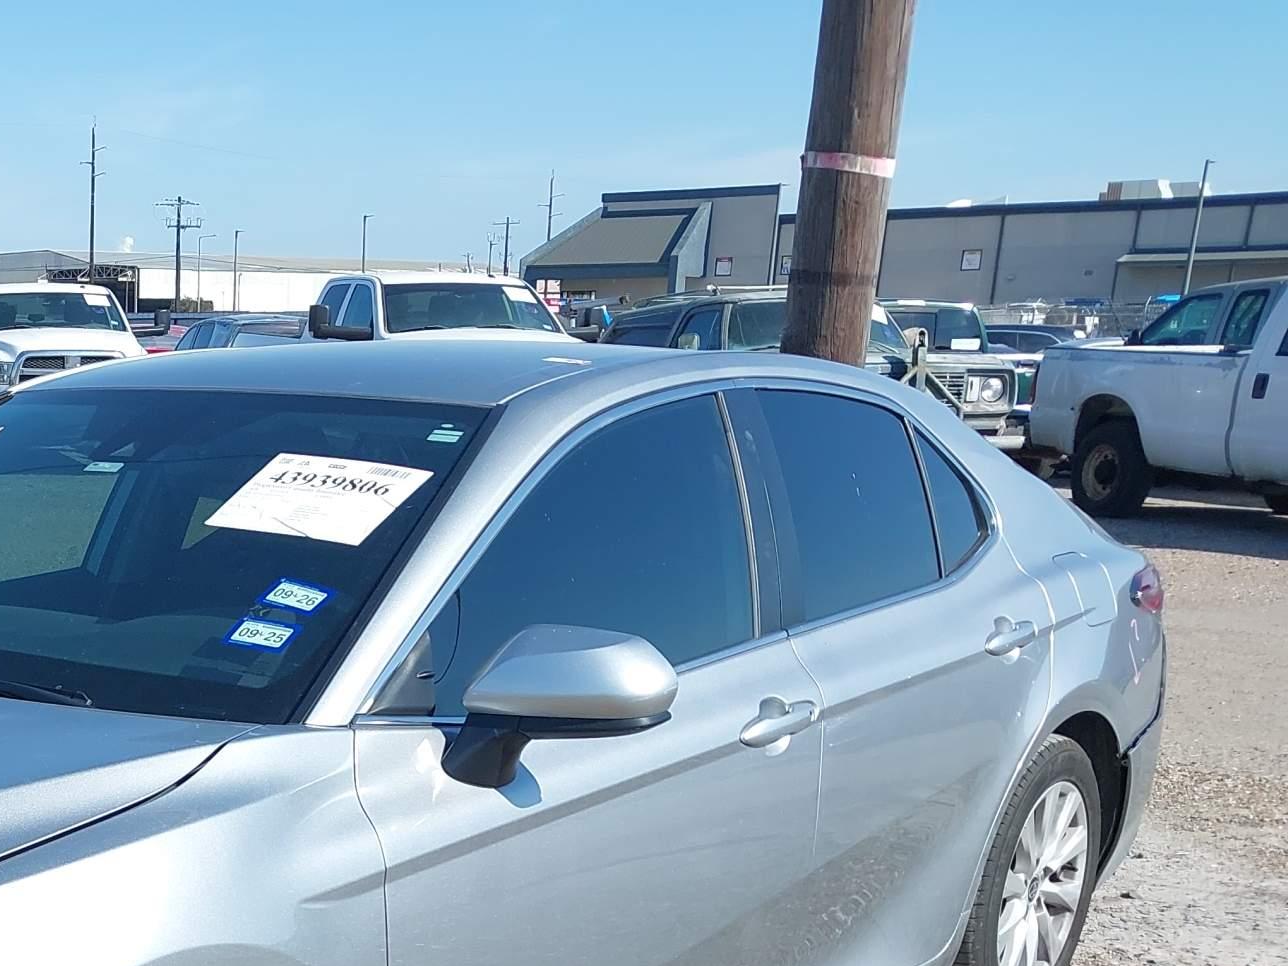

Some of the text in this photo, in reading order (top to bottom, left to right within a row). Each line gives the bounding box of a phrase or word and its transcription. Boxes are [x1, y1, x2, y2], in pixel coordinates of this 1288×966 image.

[269, 470, 394, 497] 43939806
[273, 588, 319, 606] 09 26
[238, 627, 287, 643] 09 25
